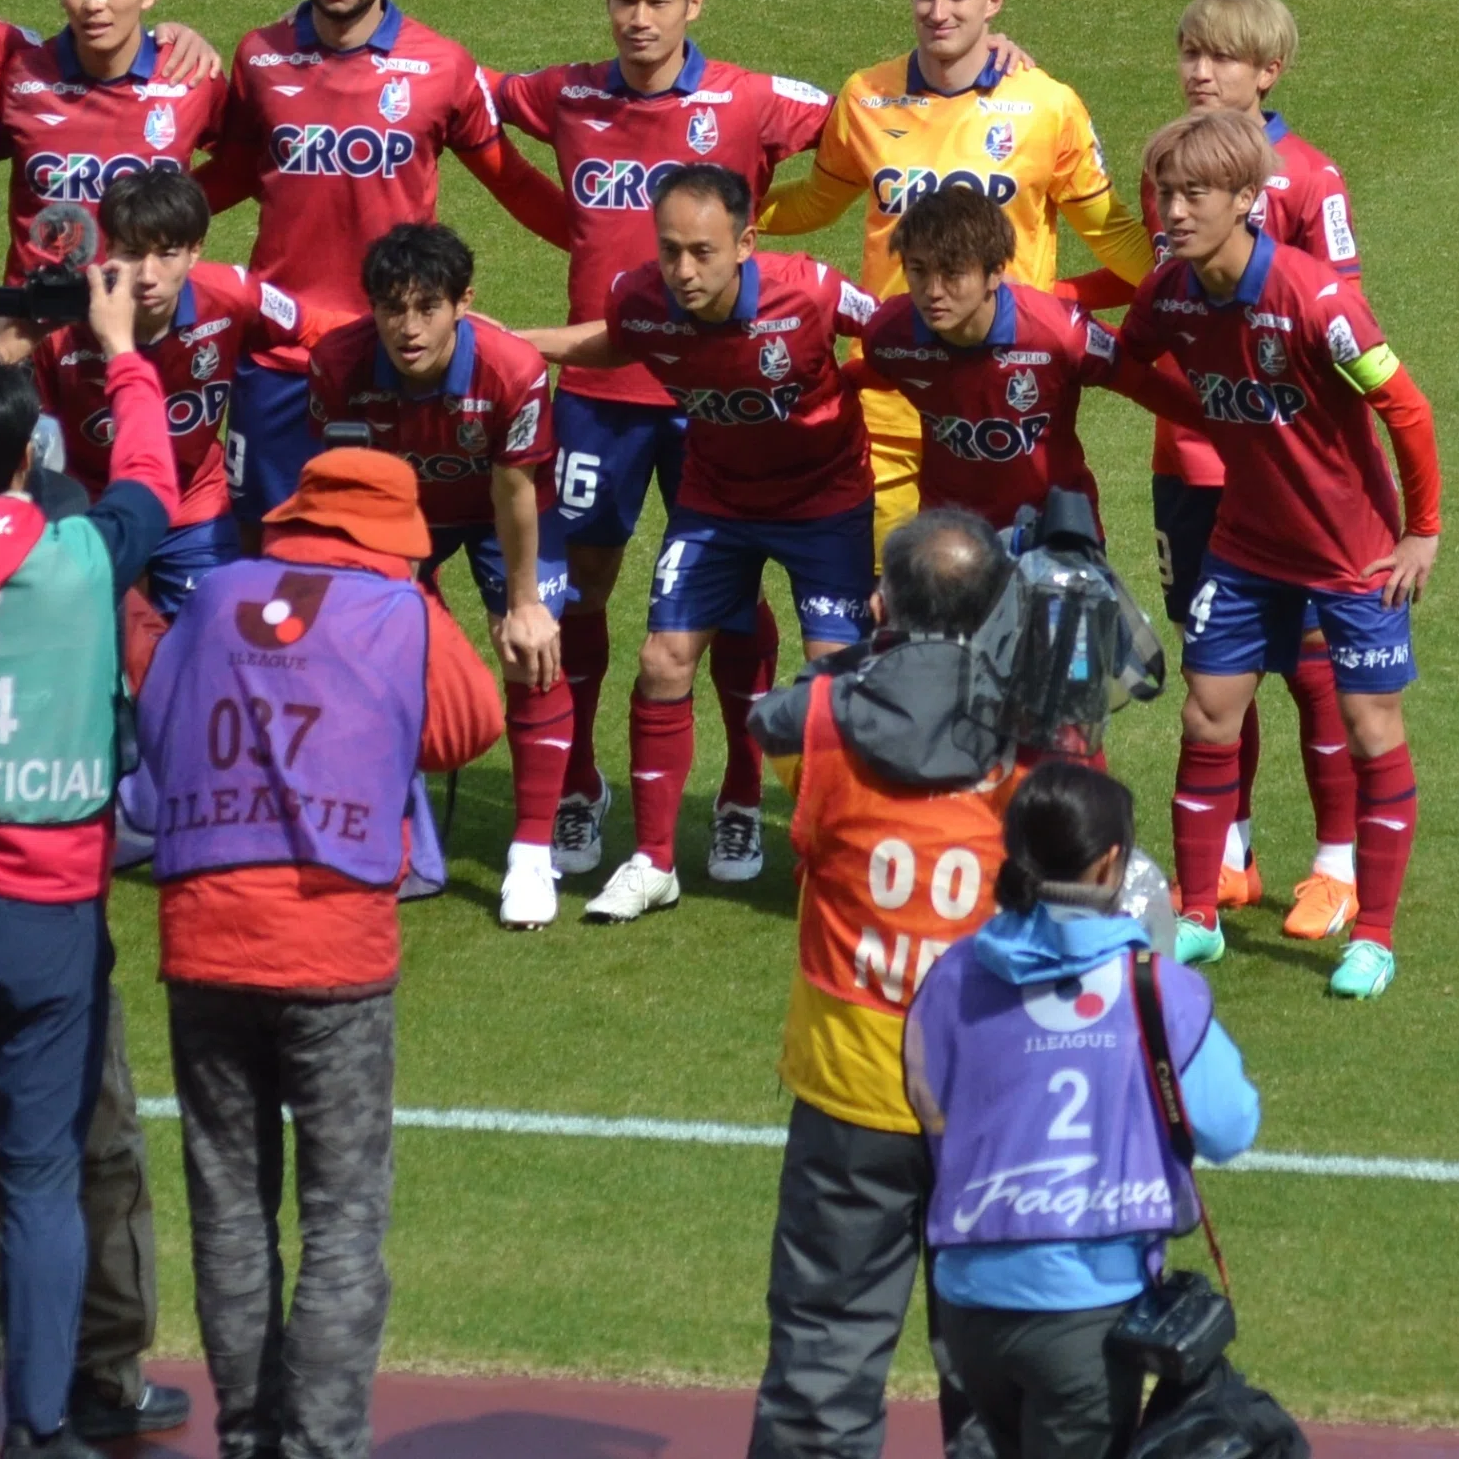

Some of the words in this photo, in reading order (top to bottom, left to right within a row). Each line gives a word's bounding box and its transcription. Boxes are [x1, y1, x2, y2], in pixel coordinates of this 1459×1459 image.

[268, 123, 415, 179] GROP
[757, 316, 801, 333] SERIO
[1008, 350, 1051, 365] SERIO
[81, 380, 232, 446] GOP
[655, 540, 686, 595] 4
[207, 696, 322, 771] 037
[868, 837, 982, 922] 00
[1023, 1033, 1117, 1054] J.LEAGUE
[1047, 1068, 1091, 1141] 2
[952, 1153, 1172, 1234] Fagian
